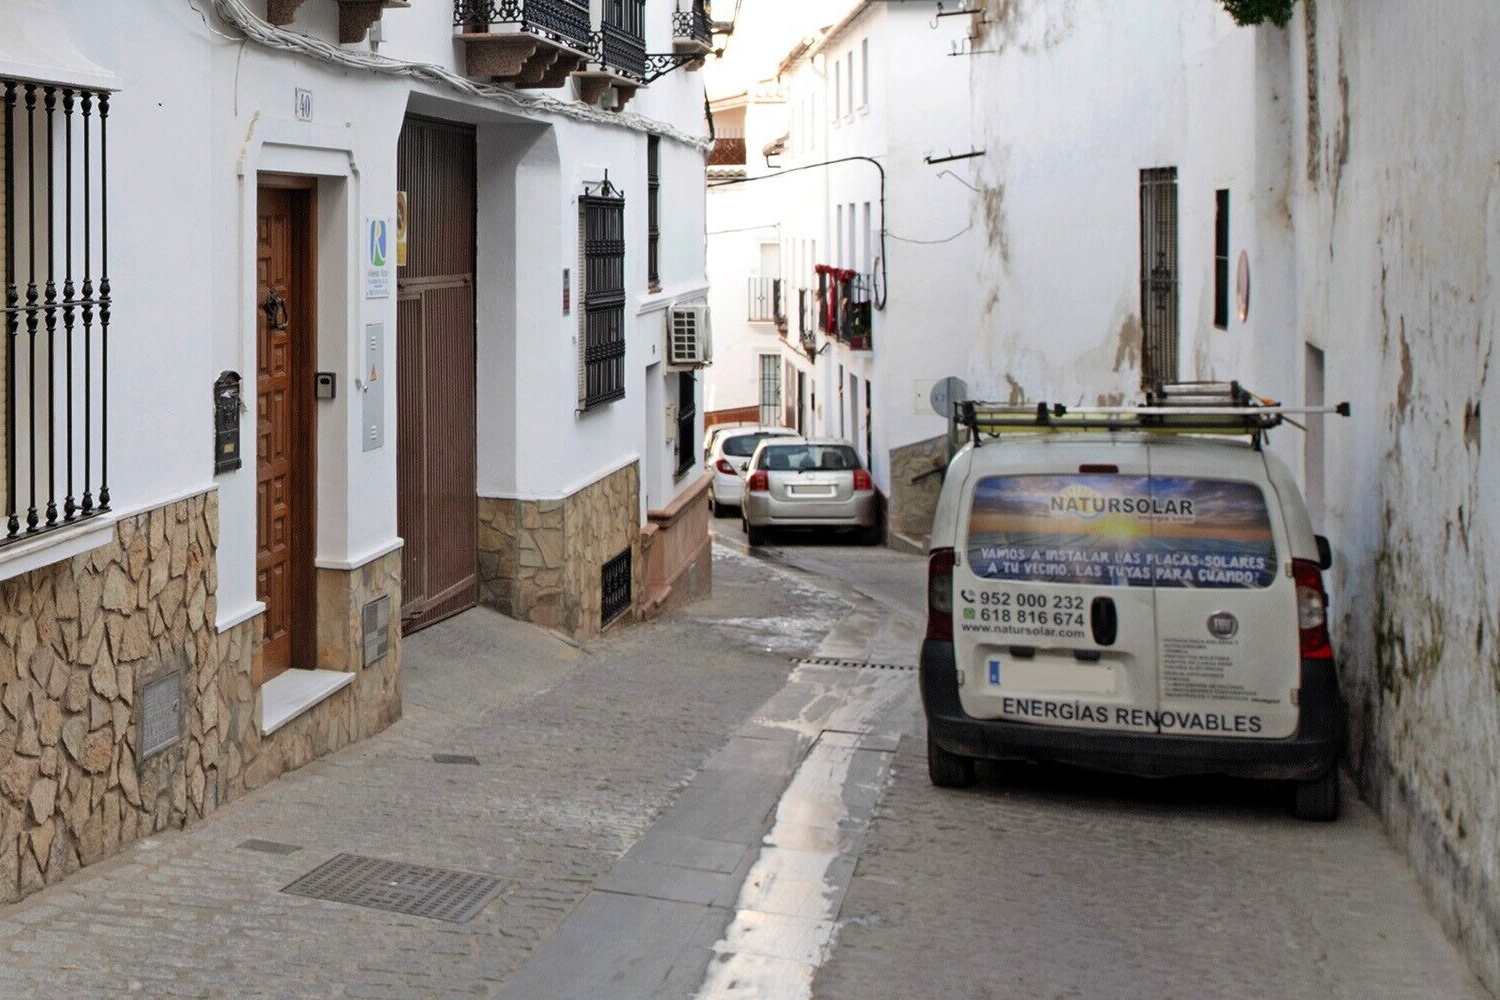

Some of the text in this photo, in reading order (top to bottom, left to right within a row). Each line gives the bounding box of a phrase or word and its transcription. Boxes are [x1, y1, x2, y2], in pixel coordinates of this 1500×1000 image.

[299, 92, 311, 118] 40
[1050, 496, 1194, 515] NATURSOLAR
[981, 547, 1265, 569] VAMOS A INSTALAR LAS PLACAS SOLARES
[987, 561, 998, 573] A
[1003, 562, 1019, 574] TU
[1075, 564, 1102, 577] LAS
[1108, 565, 1150, 579] TUYAS
[1156, 566, 1194, 581] PARA
[980, 591, 1085, 610] 952 000 232
[981, 608, 1085, 627] 618 816 674
[961, 623, 1085, 639] www.natursolar.com
[1002, 697, 1263, 733] ENERGÍAS RENOVABLES
